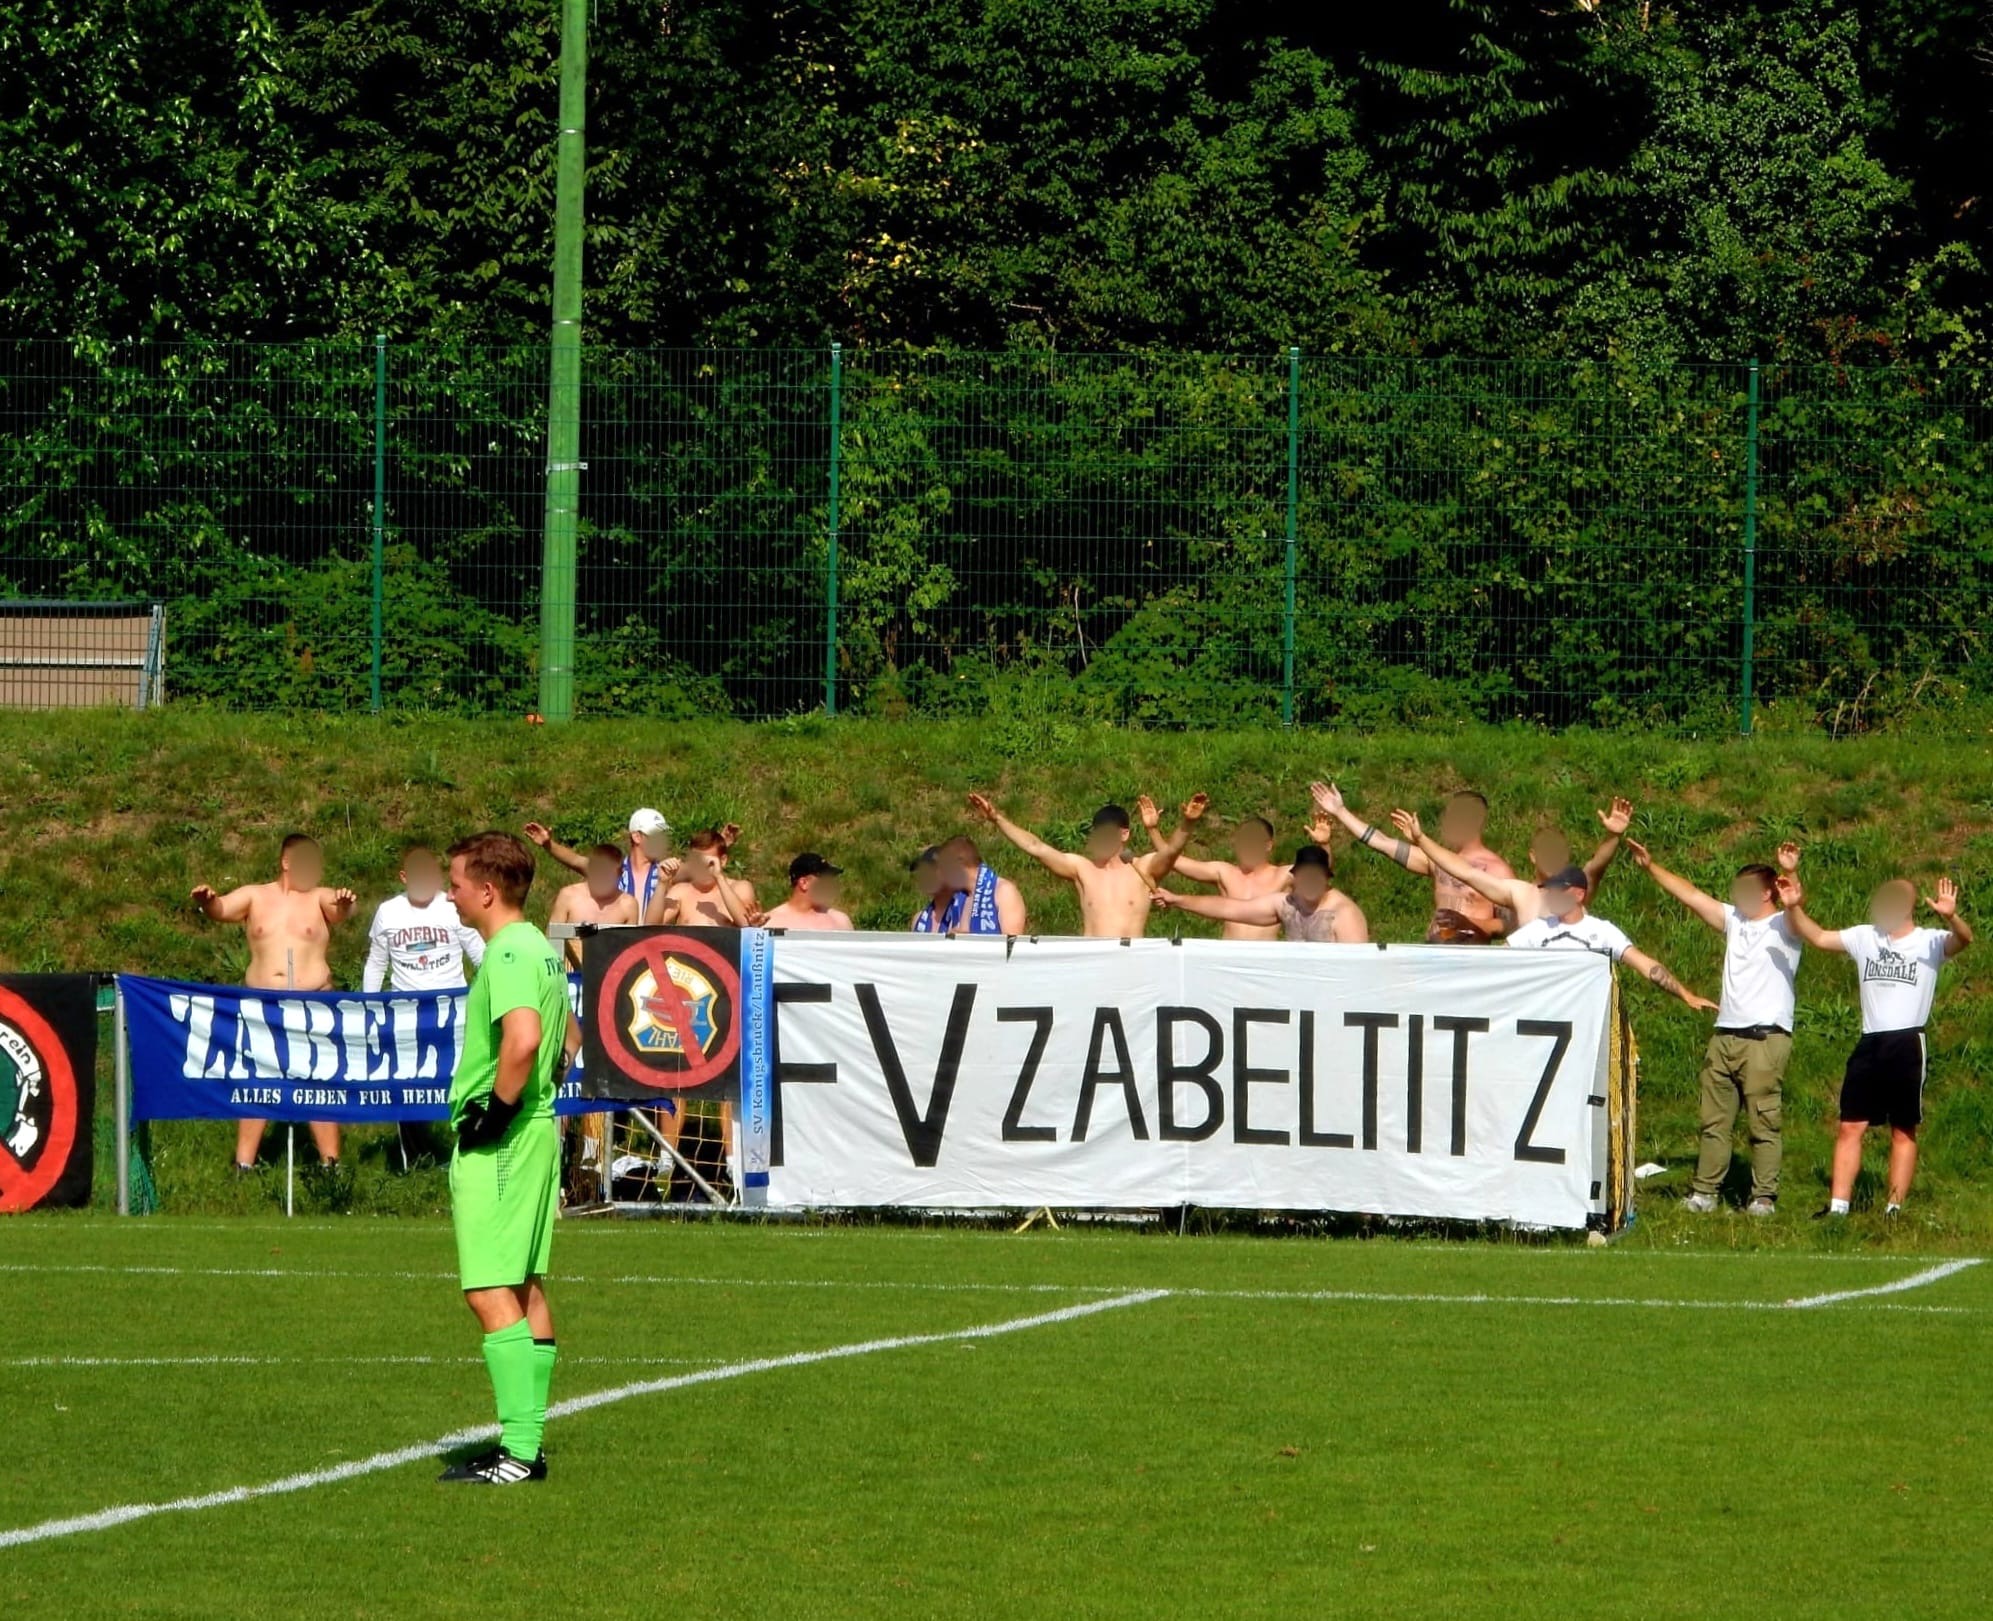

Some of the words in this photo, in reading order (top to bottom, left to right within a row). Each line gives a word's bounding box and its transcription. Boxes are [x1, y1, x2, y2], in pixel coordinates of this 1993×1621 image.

[393, 926, 450, 947] UNFAIR
[1864, 957, 1918, 981] LONSDALE
[230, 1088, 281, 1104] ALLES
[293, 1088, 348, 1105] GEBEN
[402, 1088, 454, 1105] HEIM
[996, 1005, 1574, 1165] ZABELTITZ
[752, 1112, 764, 1135] SV
